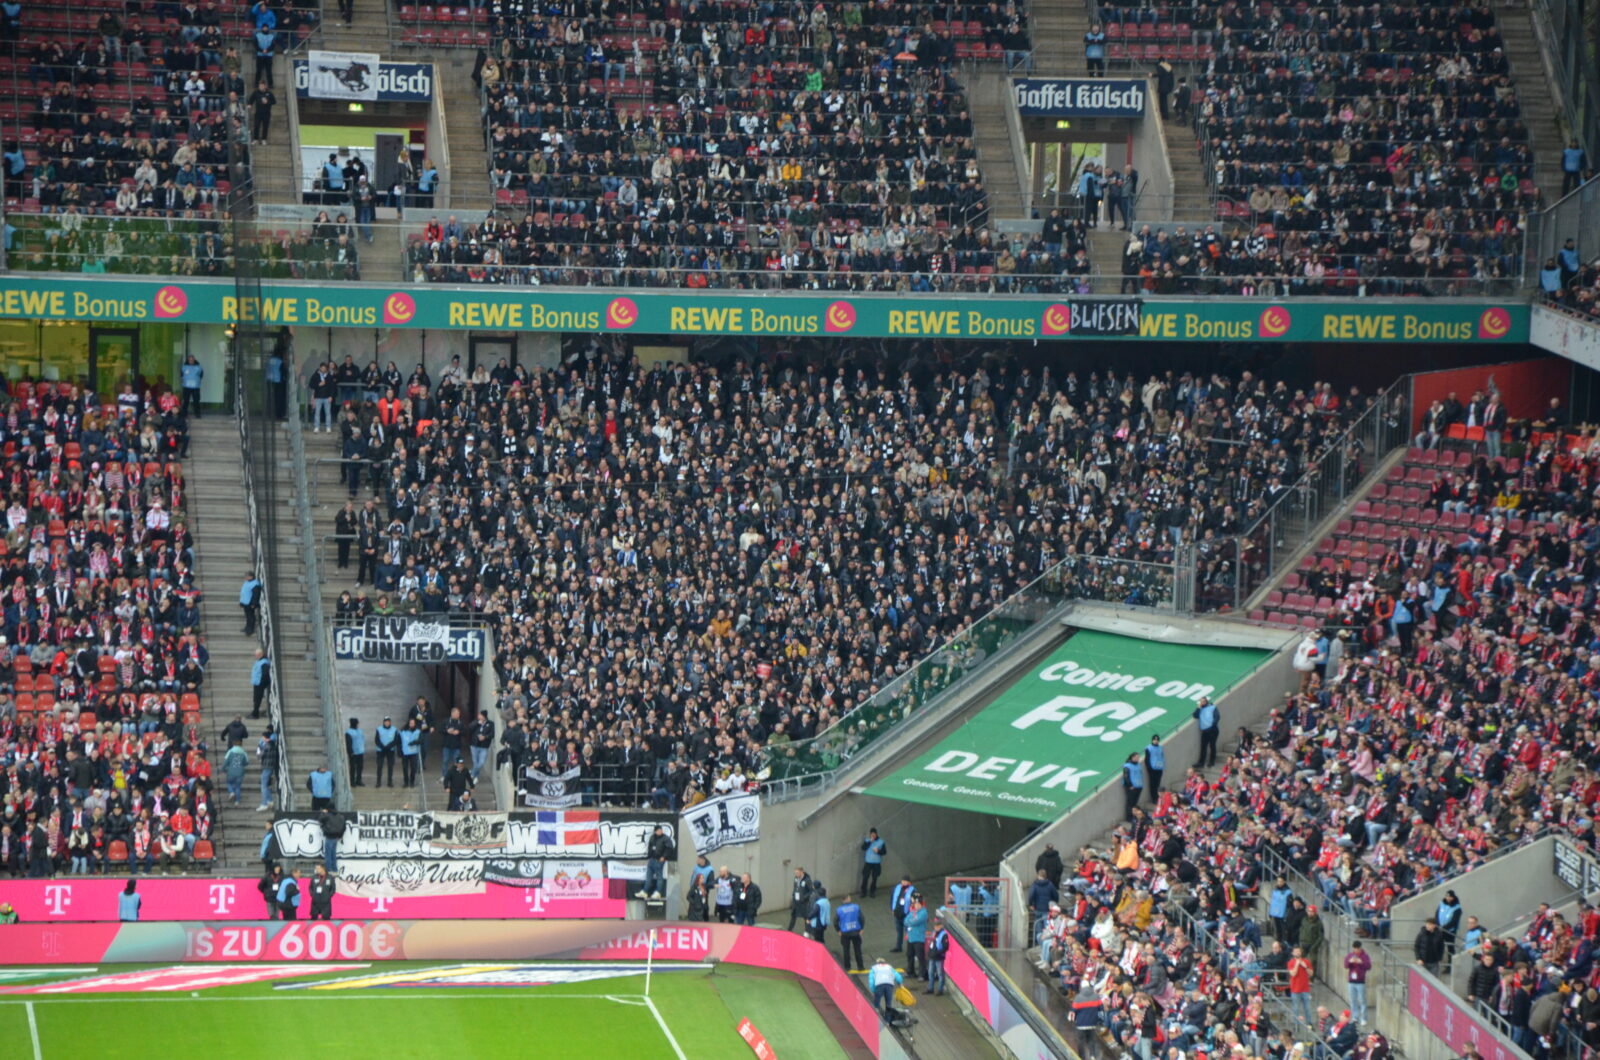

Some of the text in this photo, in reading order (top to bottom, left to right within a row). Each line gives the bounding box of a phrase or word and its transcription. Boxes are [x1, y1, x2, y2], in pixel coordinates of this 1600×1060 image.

[377, 67, 430, 97] ölsch
[1014, 83, 1144, 112] Gaffel Kölsch
[74, 291, 147, 317] Bonus
[222, 296, 376, 324] REWE Bonus
[449, 302, 599, 329] REWE Bonus
[670, 307, 818, 332] REWE Bonus
[888, 310, 1035, 335] REWE Bonus
[1139, 313, 1252, 338] WE Bonus
[1323, 315, 1472, 339] REWE Bonus
[364, 616, 407, 641] ELV
[363, 641, 445, 662] UNITED
[1039, 661, 1156, 692] Come
[1010, 695, 1167, 742] FC!
[924, 751, 1099, 793] DEVK
[359, 828, 416, 840] KOLLEKTIV
[426, 863, 482, 888] Unity
[45, 885, 71, 914] T
[209, 885, 235, 914] T
[222, 929, 262, 956] ZU
